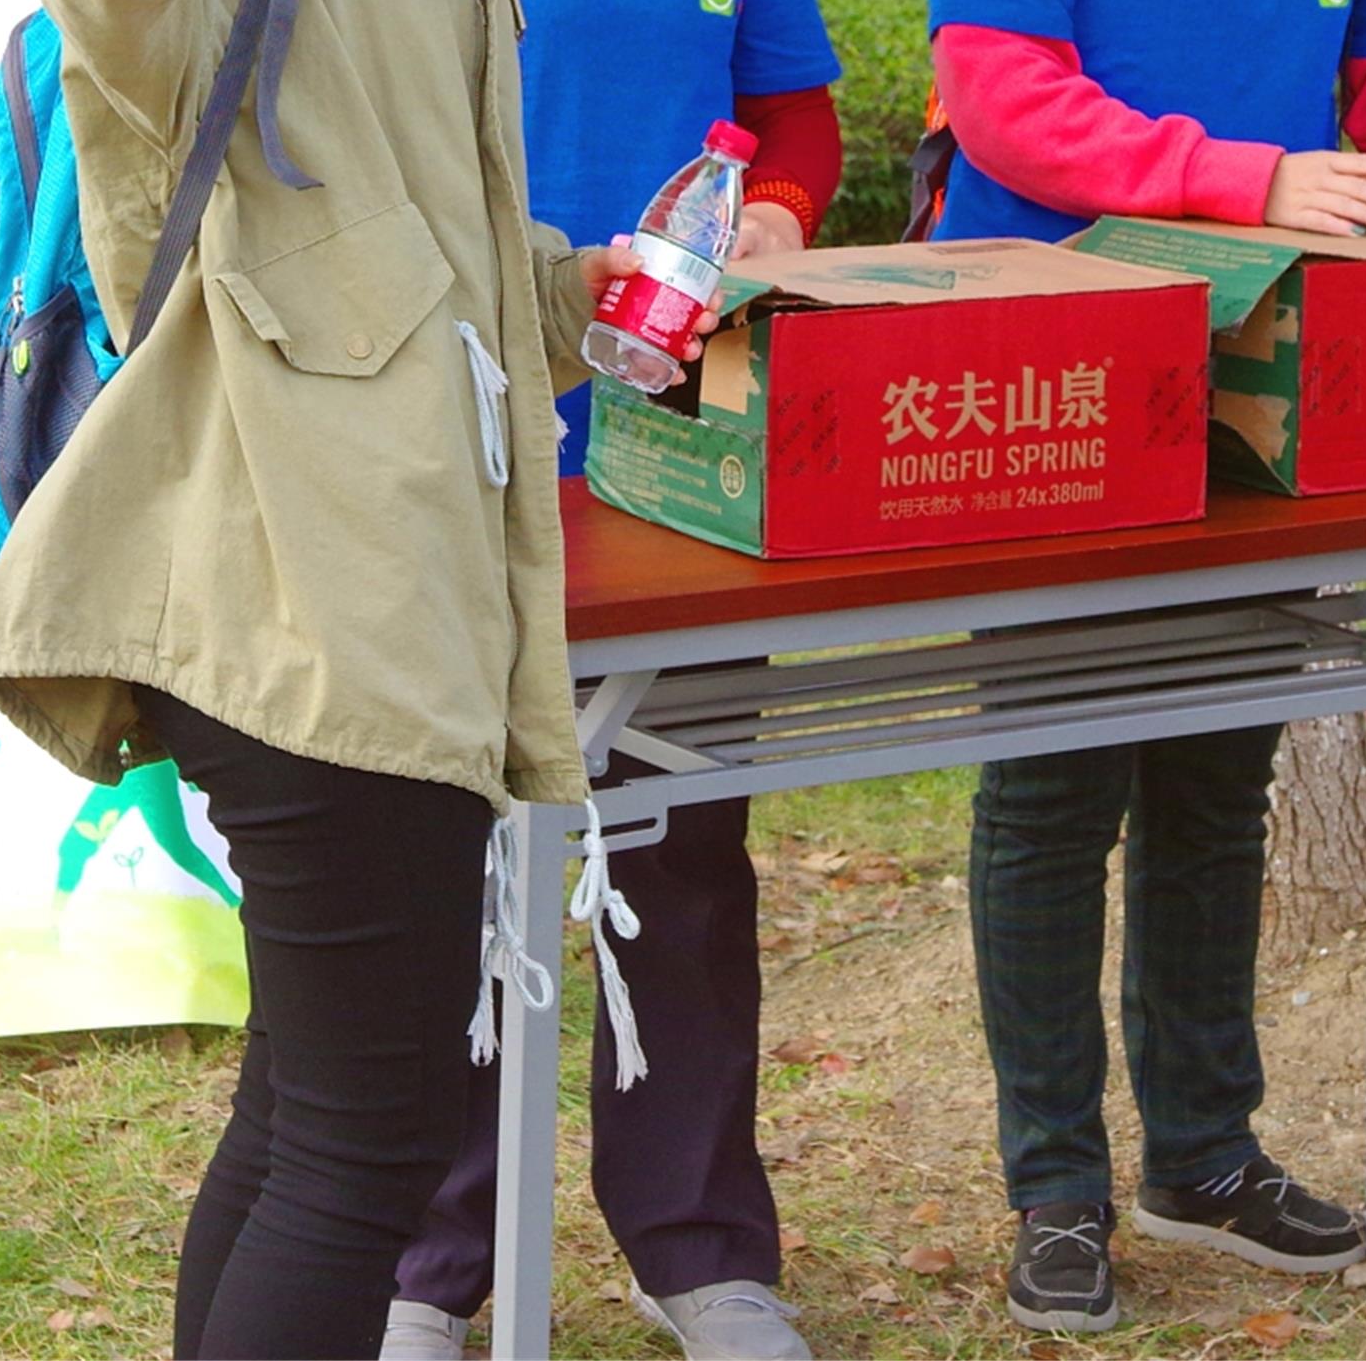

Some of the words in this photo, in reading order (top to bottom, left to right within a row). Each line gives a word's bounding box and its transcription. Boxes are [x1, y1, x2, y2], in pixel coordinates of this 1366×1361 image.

[881, 361, 1109, 446] 农夫山泉
[881, 447, 994, 488] NONGFU
[1006, 437, 1106, 476] SPRING
[878, 493, 964, 521] 饮用天然水
[1016, 479, 1105, 508] 24x380ml
